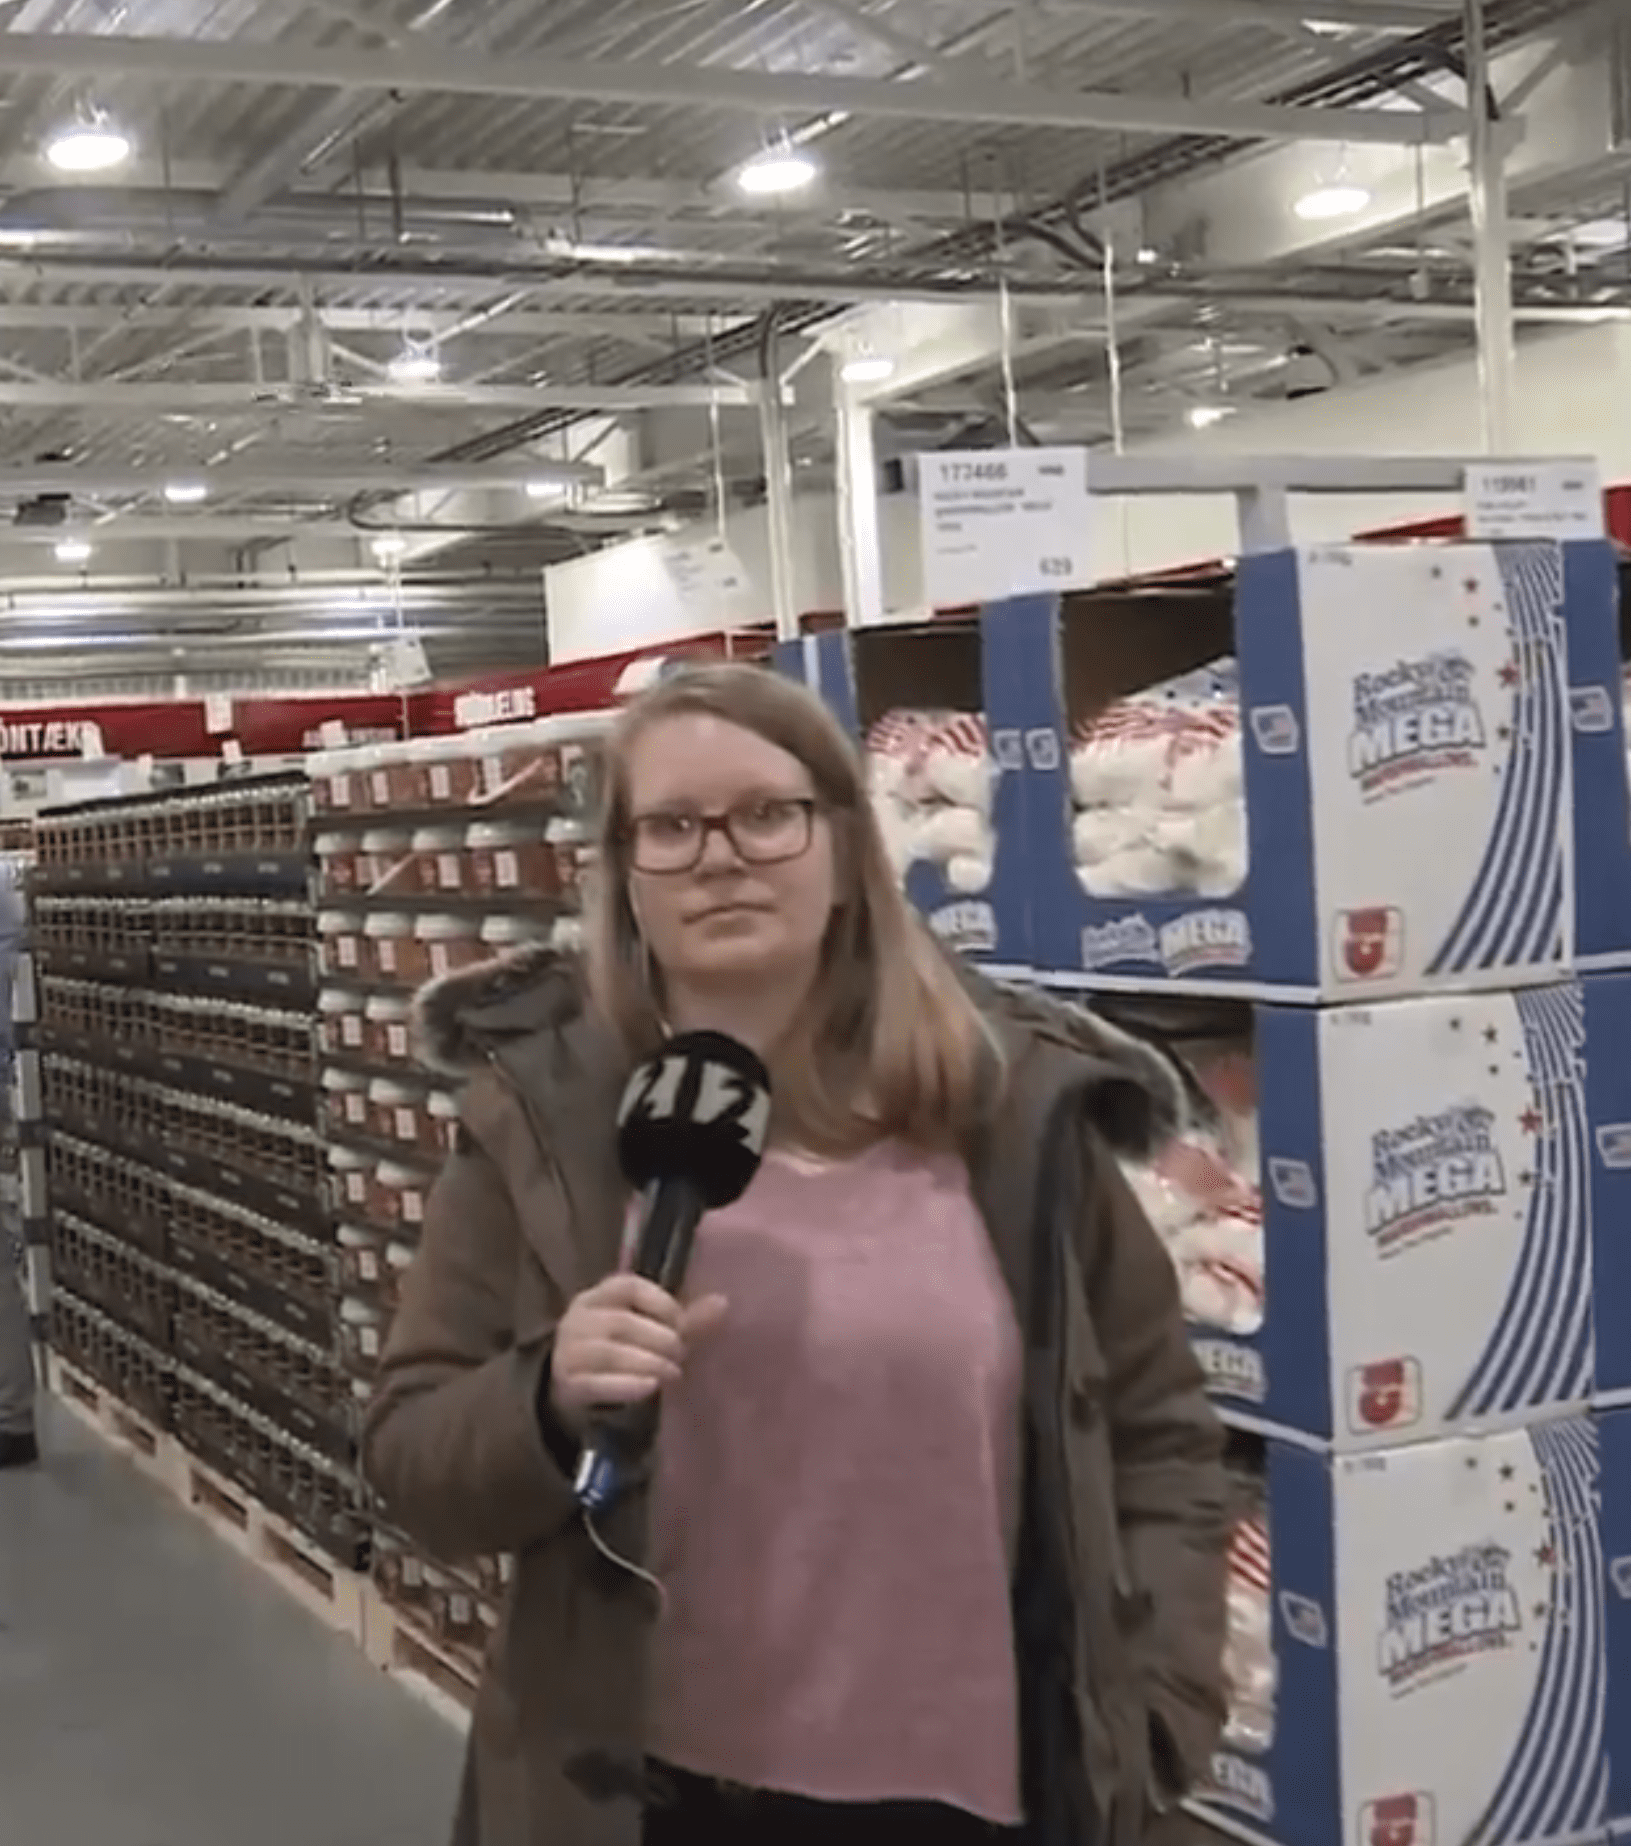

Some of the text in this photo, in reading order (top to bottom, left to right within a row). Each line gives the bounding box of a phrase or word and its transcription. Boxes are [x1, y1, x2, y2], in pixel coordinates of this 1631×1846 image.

[1349, 702, 1484, 778] MEGA
[1365, 1148, 1506, 1236] MEGA
[1378, 1583, 1521, 1676] MEGA
